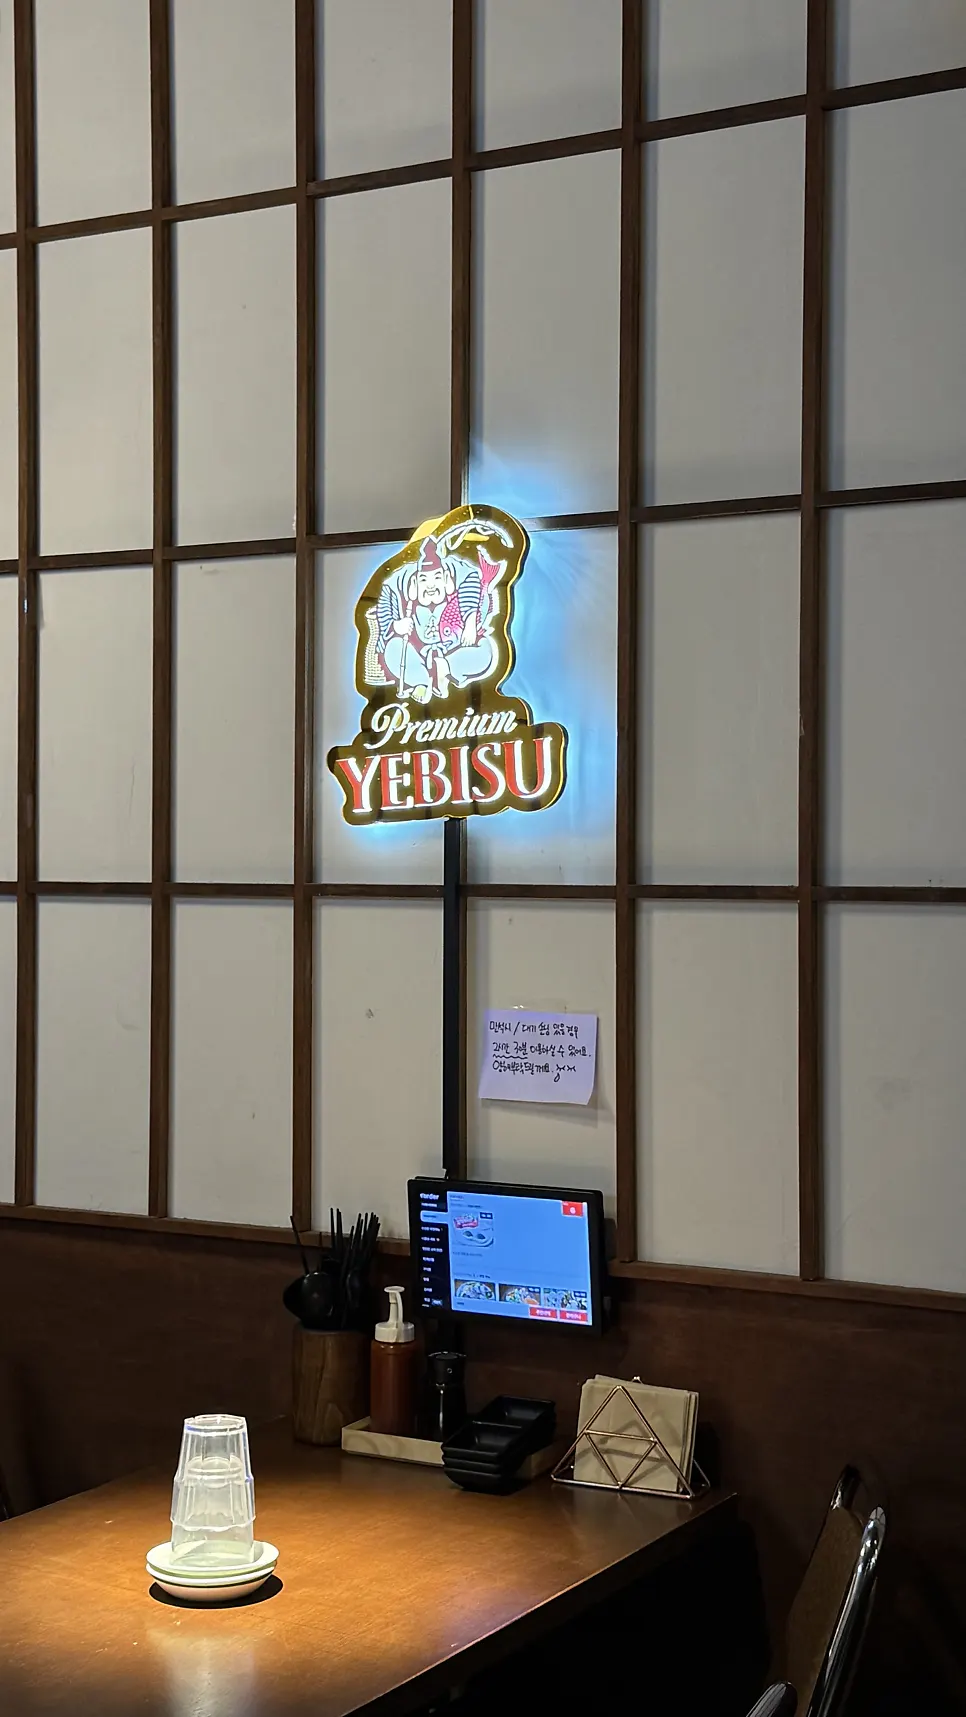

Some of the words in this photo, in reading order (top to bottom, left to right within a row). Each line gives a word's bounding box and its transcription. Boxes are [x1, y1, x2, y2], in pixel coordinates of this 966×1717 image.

[363, 700, 518, 750] Premium
[336, 736, 554, 814] YEBISU
[522, 1024, 537, 1033] 대기
[538, 1021, 550, 1036] 손님
[492, 1041, 510, 1054] 2시간
[529, 1042, 556, 1057] 이용하실
[557, 1044, 565, 1058] 수
